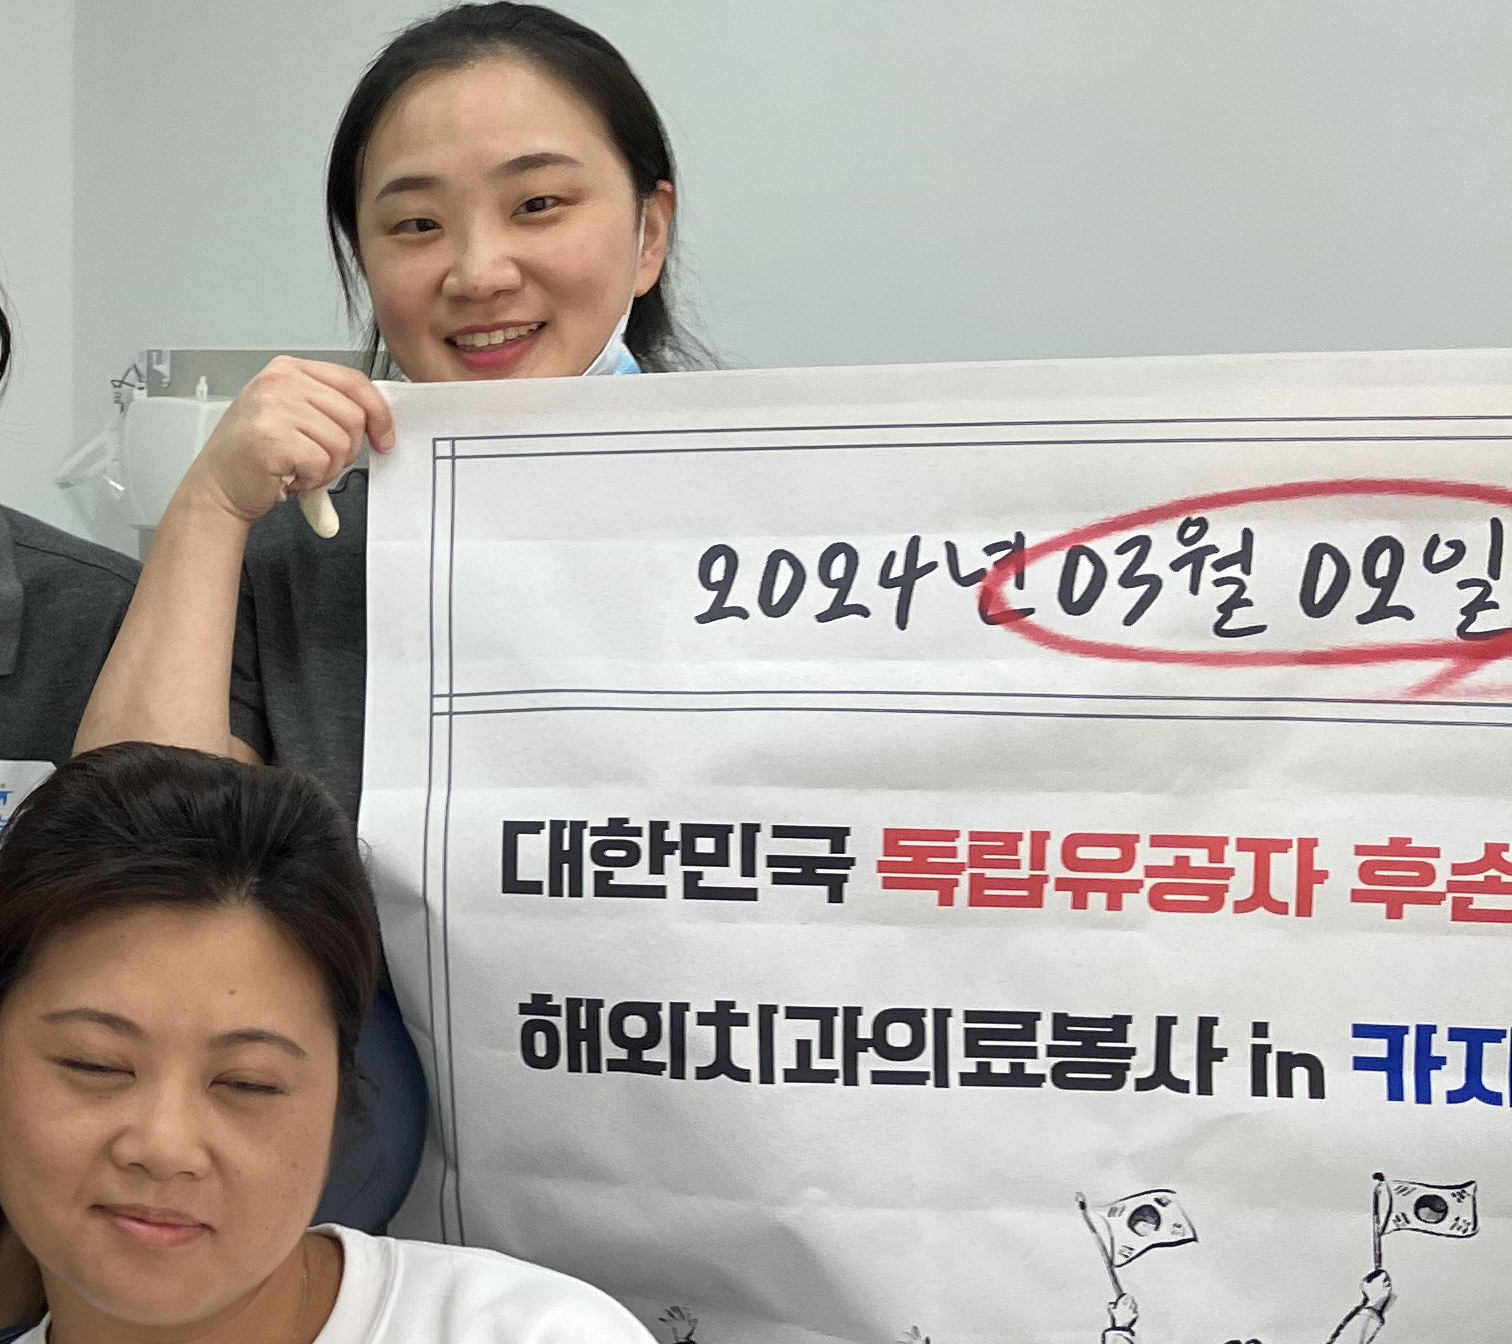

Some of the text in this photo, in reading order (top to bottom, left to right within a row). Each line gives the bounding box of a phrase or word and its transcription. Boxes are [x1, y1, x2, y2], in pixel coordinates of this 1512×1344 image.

[693, 515, 1511, 642] 2024년 03월 02일
[501, 816, 856, 905] 대한민국
[876, 826, 1329, 919] 독립유공자
[518, 992, 1511, 1108] 해외치과의료봉사 in 카자
